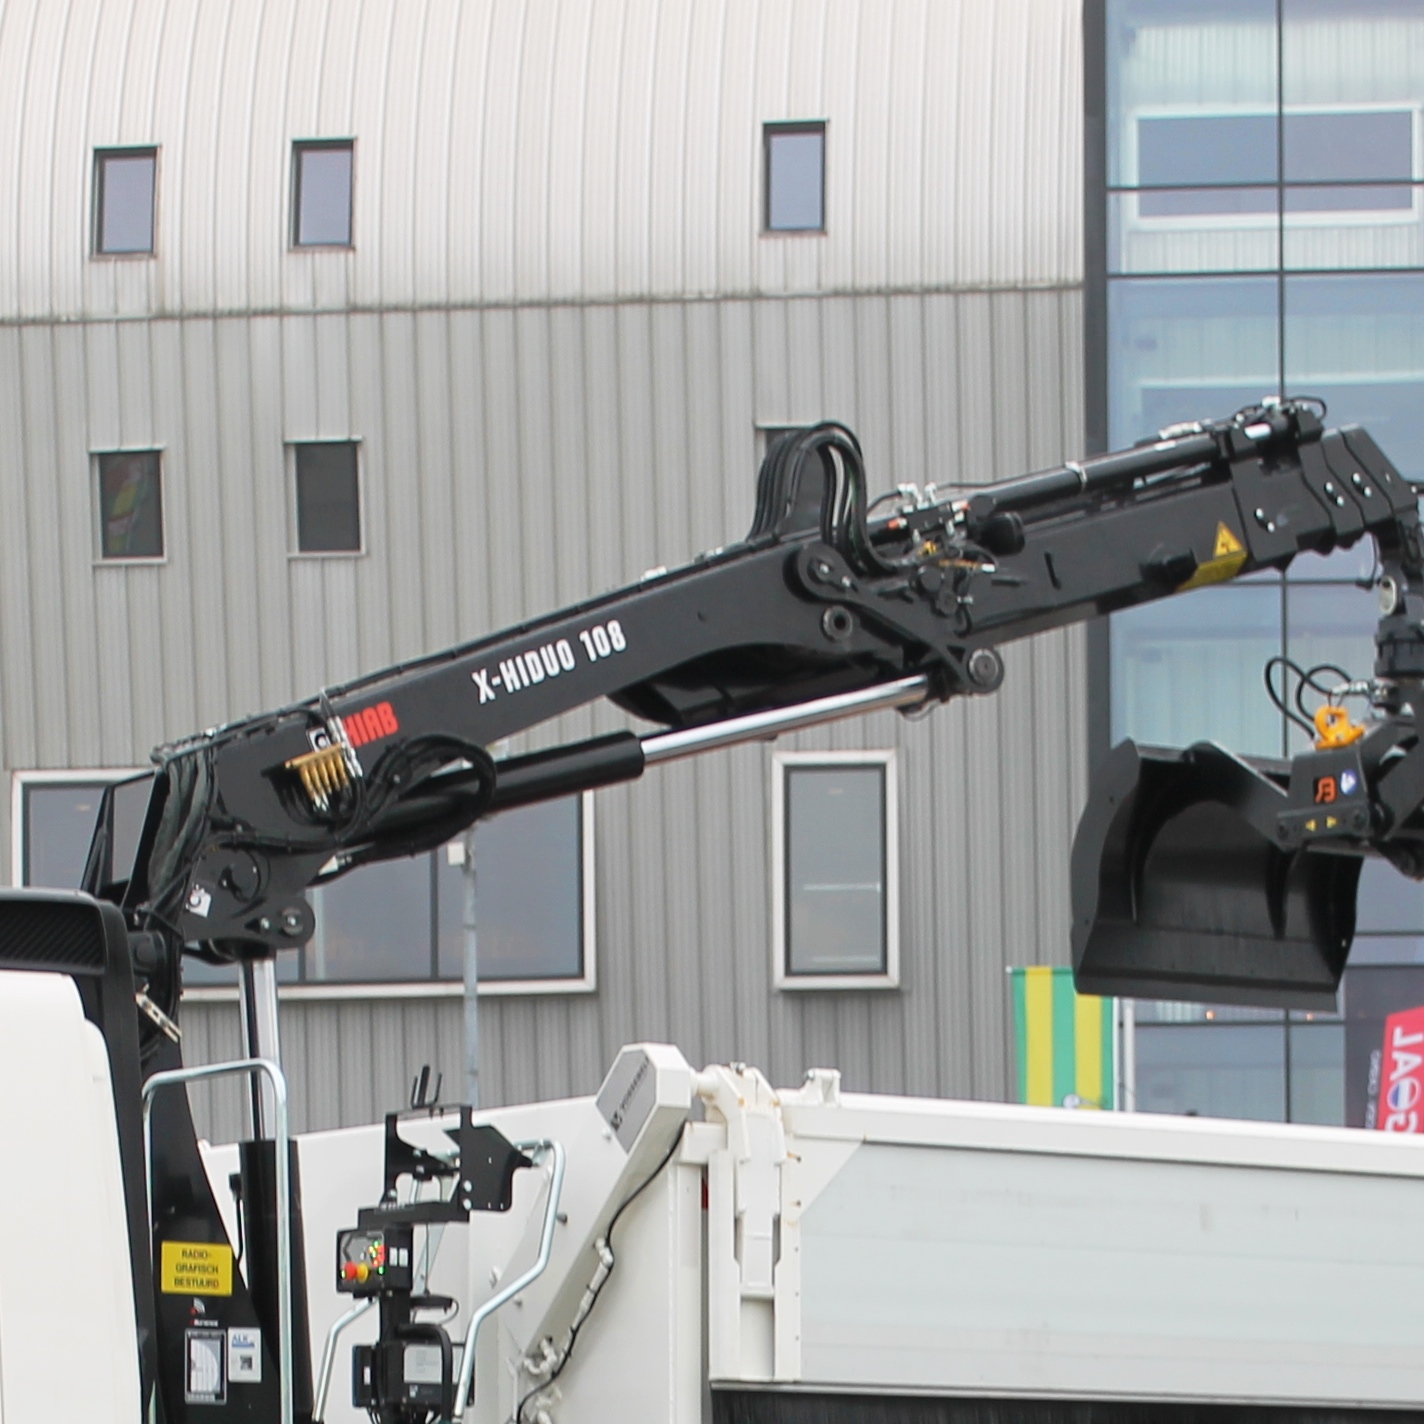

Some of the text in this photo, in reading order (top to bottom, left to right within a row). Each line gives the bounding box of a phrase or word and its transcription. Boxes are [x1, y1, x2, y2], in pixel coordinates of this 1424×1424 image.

[471, 619, 627, 704] X-HIDUO 108
[343, 701, 400, 748] HIAB
[181, 1248, 213, 1260] RADIO-
[175, 1263, 219, 1275] GRAFISCH
[174, 1277, 220, 1290] BESTUURD
